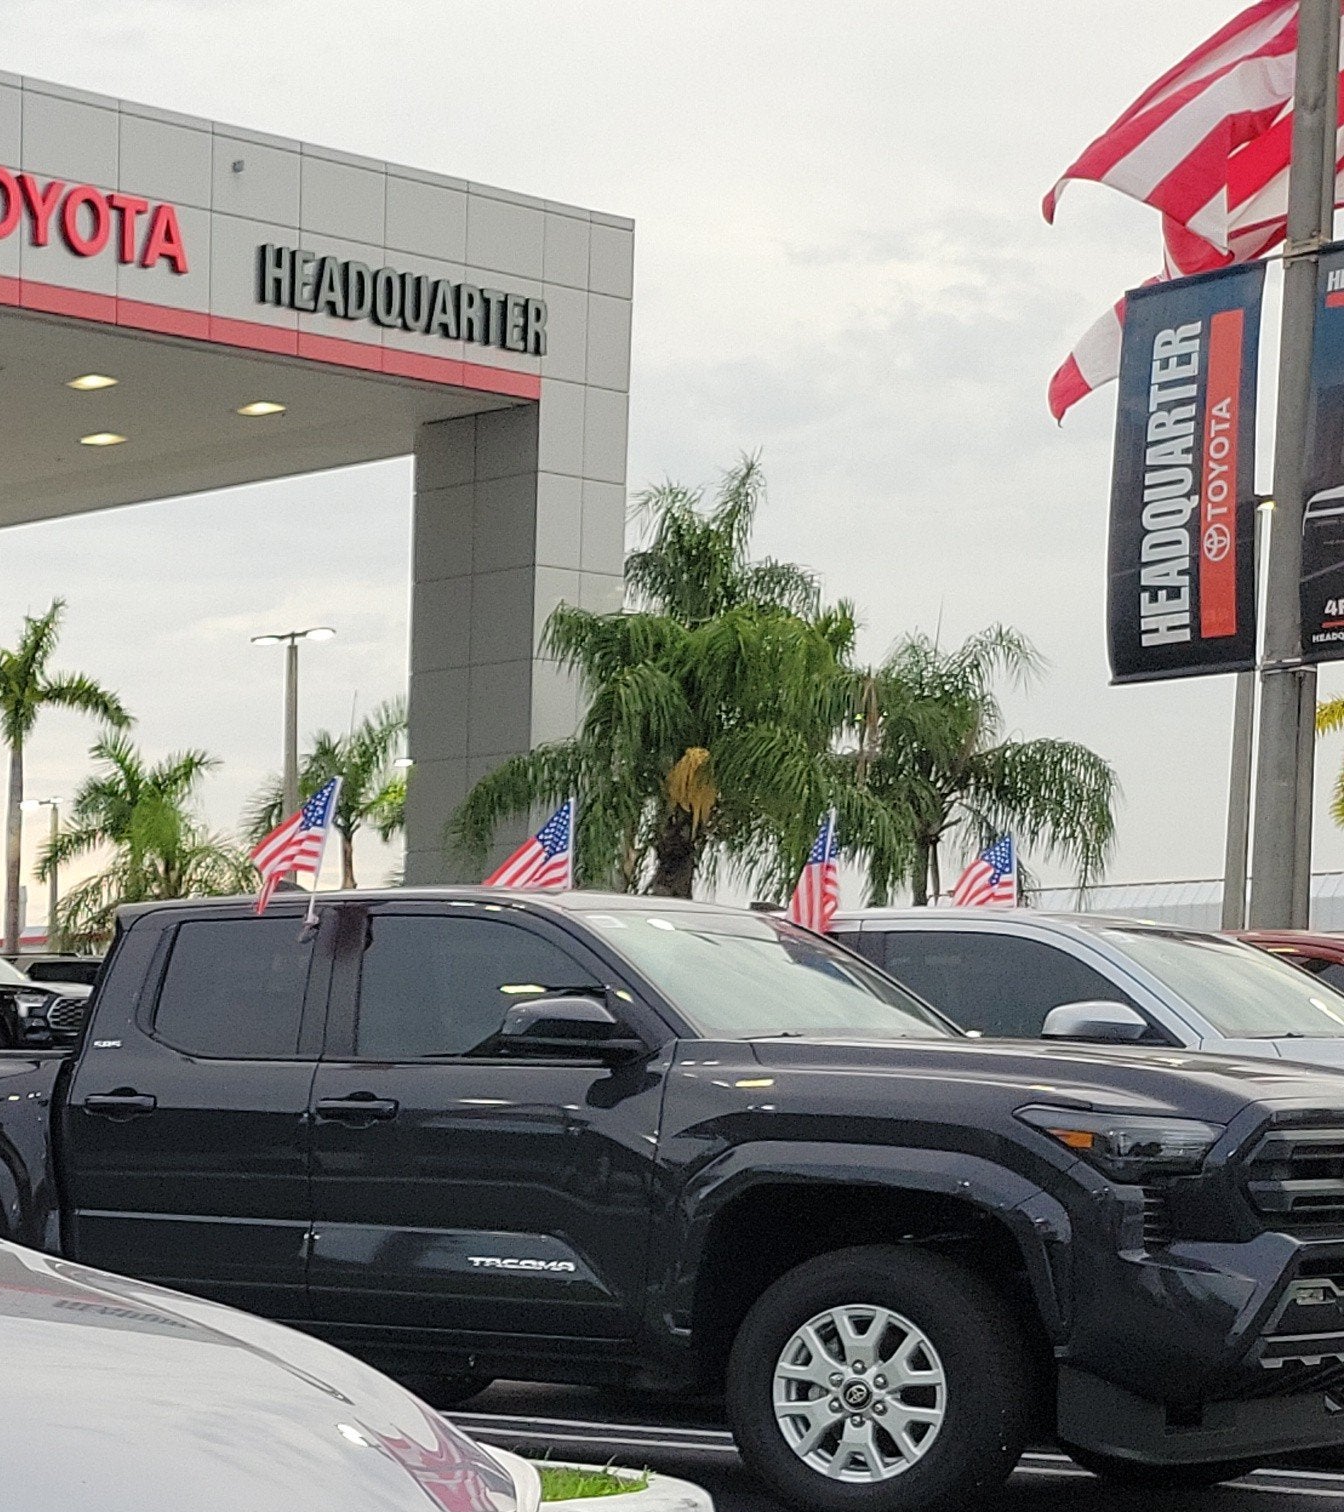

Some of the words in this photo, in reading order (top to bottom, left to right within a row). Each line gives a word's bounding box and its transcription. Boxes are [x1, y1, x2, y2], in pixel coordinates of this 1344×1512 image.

[259, 243, 548, 356] HEADQUARTER
[1140, 320, 1202, 647] HEADQUARTER
[1206, 397, 1232, 519] TOYOTA
[467, 1256, 578, 1273] TACOMA
